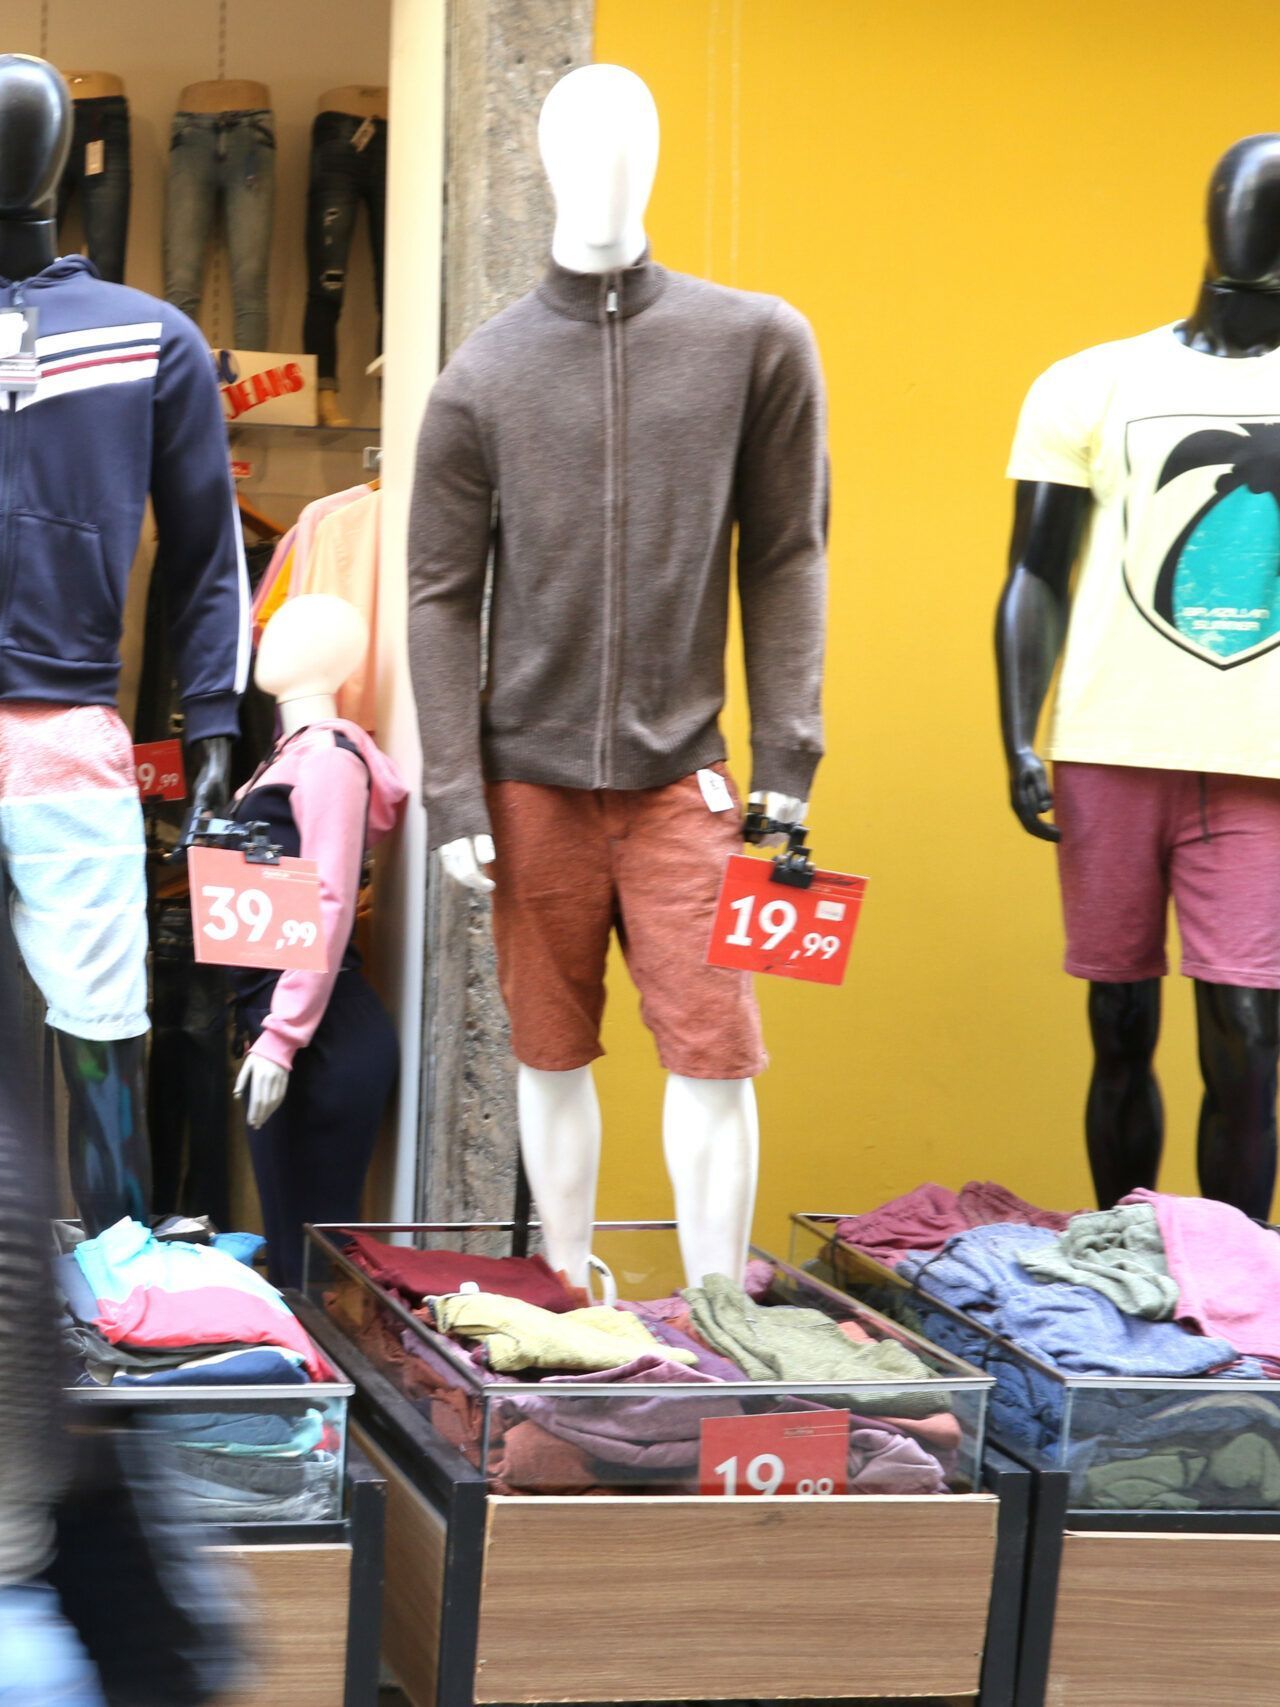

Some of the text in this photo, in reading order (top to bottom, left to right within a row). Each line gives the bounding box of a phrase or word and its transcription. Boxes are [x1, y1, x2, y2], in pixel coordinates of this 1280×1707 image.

[135, 762, 180, 792] 9,99
[201, 885, 317, 950] 39,99
[725, 895, 841, 960] 19,99
